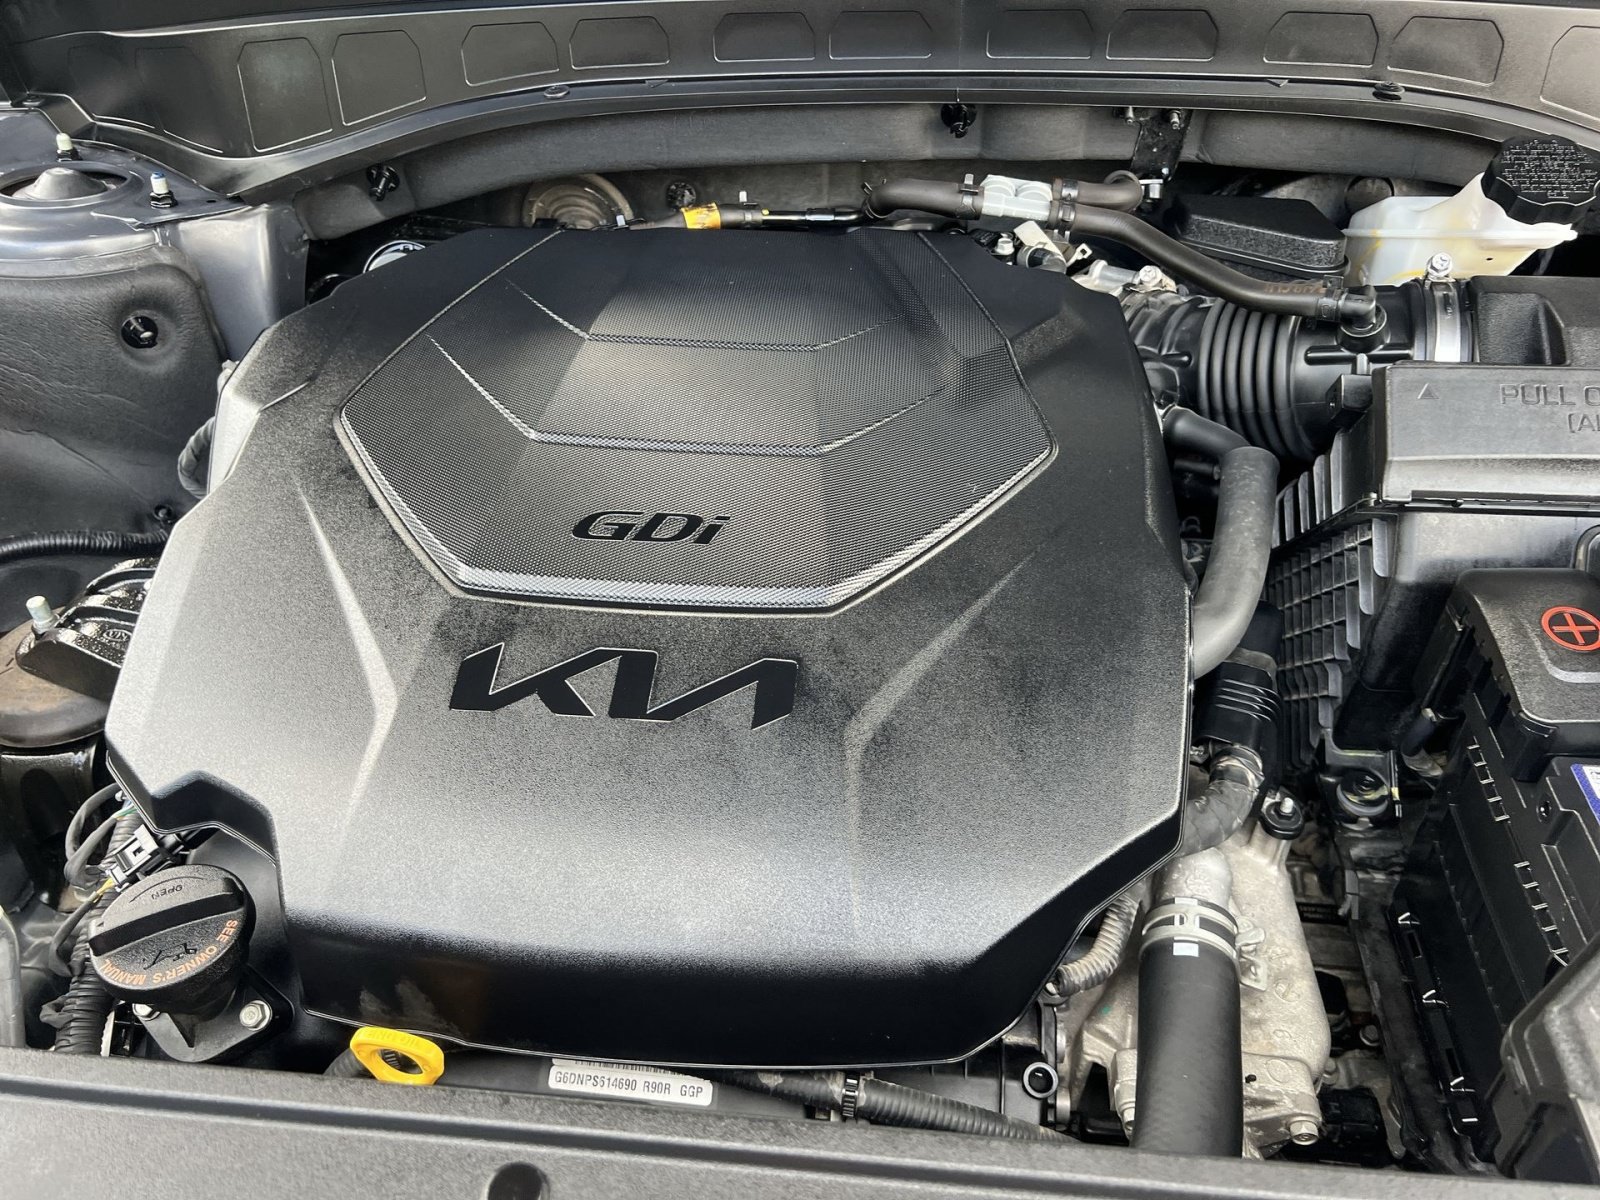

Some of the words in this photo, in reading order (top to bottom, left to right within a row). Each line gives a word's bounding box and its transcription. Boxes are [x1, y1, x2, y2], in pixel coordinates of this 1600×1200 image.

[1500, 383, 1576, 405] PULL
[572, 511, 731, 545] GDi
[449, 641, 800, 731] KIA
[151, 884, 183, 900] OPEN
[216, 919, 239, 943] SEE
[99, 958, 147, 986] MANUAL
[152, 945, 218, 984] OWNER'S
[642, 1080, 671, 1096] R90R
[680, 1084, 704, 1098] GGP
